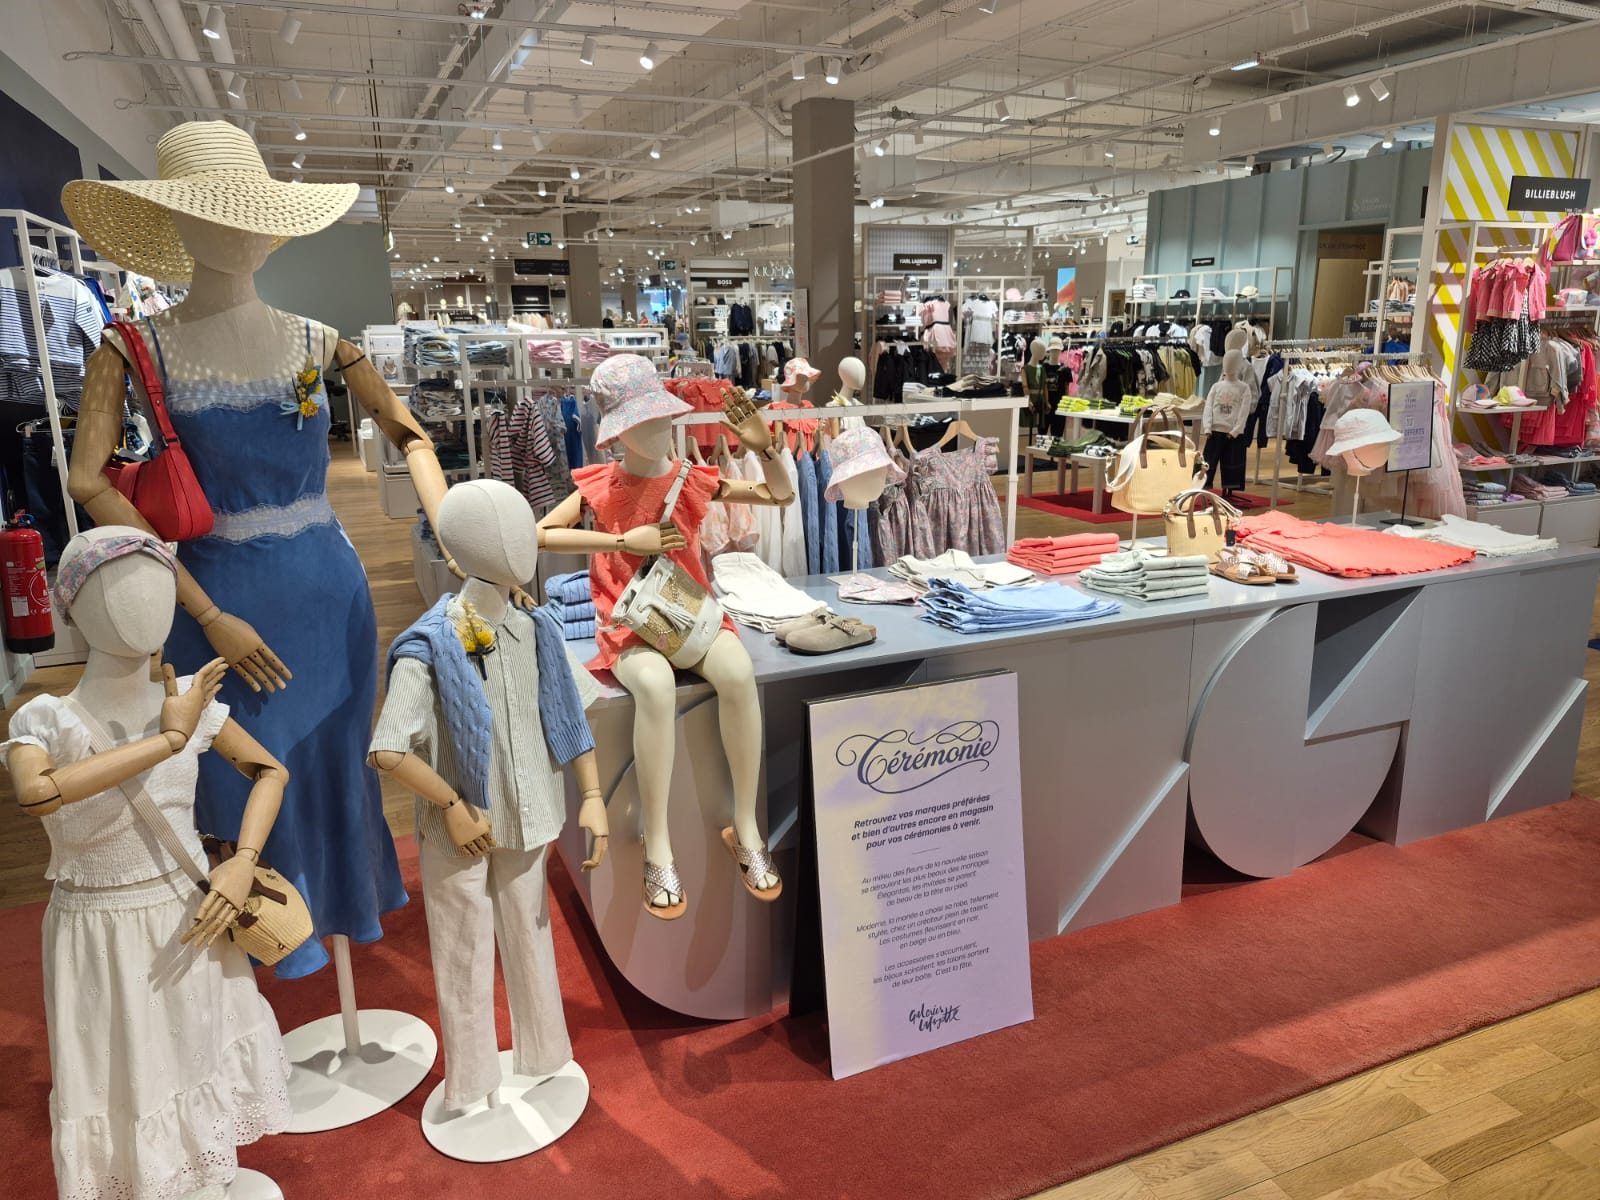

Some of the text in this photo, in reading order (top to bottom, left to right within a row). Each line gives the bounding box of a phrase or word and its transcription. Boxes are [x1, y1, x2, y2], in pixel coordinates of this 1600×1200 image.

[1525, 188, 1576, 200] BILLIEBLUSH
[837, 721, 999, 792] Cérémonie
[851, 833, 860, 841] et
[862, 829, 880, 838] bien
[882, 821, 916, 834] d'autres
[918, 815, 946, 826] encore
[960, 805, 994, 817] magasin
[854, 795, 990, 829] Retrouvez vos marques préférées
[866, 840, 886, 851] pour
[888, 836, 902, 844] vos
[904, 825, 951, 840] cérémonies
[960, 818, 980, 828] venir.
[879, 938, 890, 946] Les
